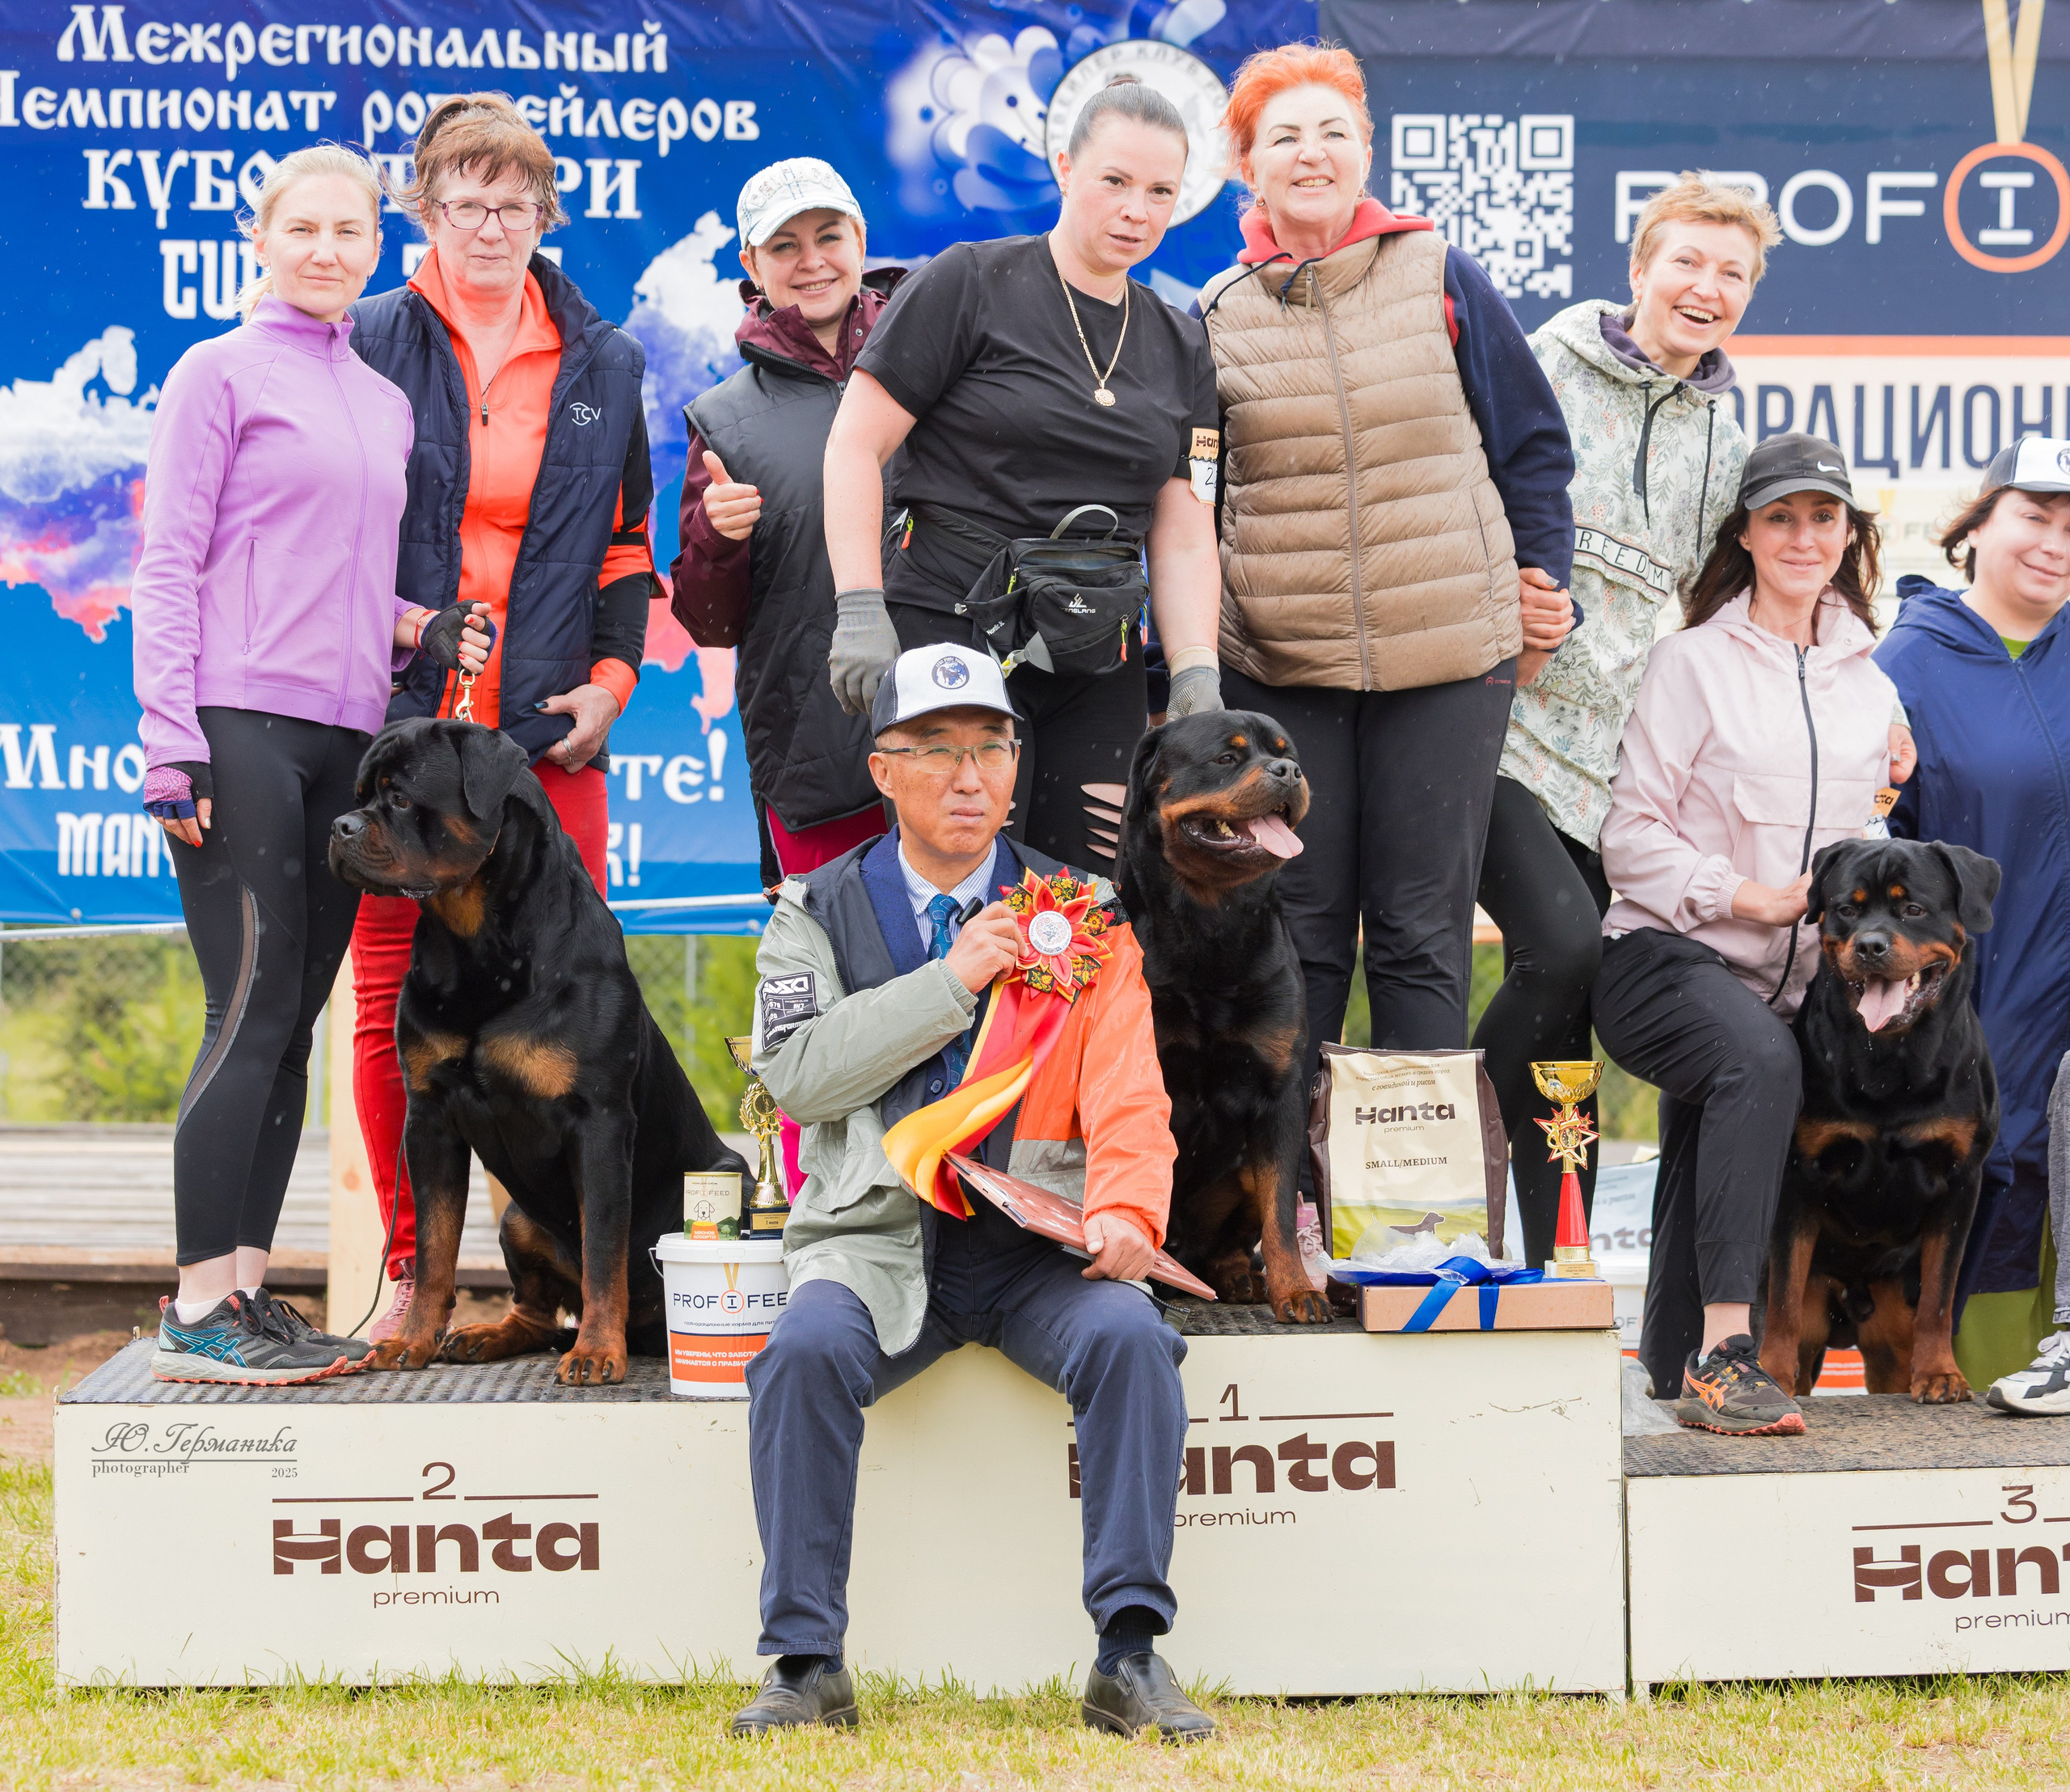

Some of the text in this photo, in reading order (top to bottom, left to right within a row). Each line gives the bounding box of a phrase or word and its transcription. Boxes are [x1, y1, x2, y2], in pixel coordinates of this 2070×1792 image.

[57, 4, 668, 81] Межрегиональный
[362, 83, 759, 158] роейлеров
[160, 240, 260, 319] CU
[570, 404, 602, 423] TCV
[1196, 435, 1219, 449] Han
[56, 812, 177, 878] MAN
[1376, 1079, 1410, 1090] говядиной
[1416, 1079, 1436, 1088] рисом
[1354, 1101, 1455, 1125] Hanta
[1384, 1125, 1425, 1134] premium
[1365, 1156, 1447, 1169] SMALL/MEDIUM
[1219, 1384, 1249, 1421] 1
[422, 1461, 457, 1500] 2
[2000, 1484, 2037, 1524] 3
[272, 1512, 600, 1575] Hanta
[1853, 1542, 2070, 1603] Han
[374, 1585, 500, 1608] premium
